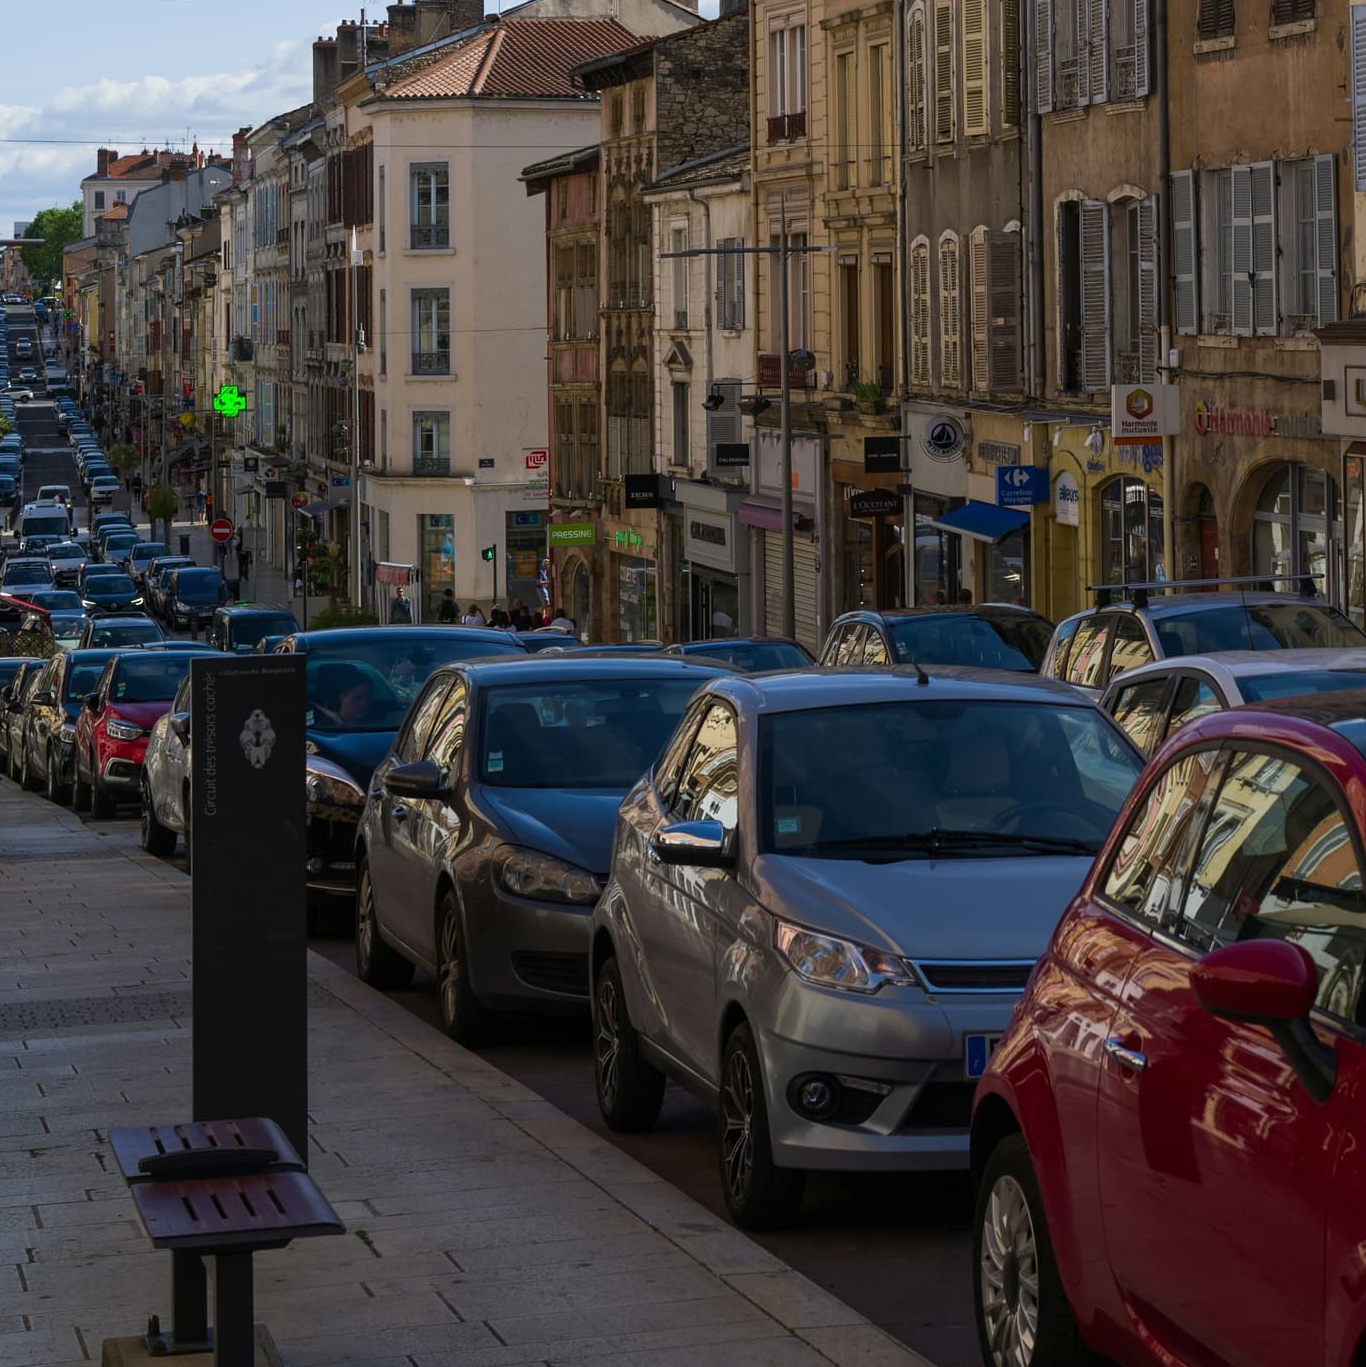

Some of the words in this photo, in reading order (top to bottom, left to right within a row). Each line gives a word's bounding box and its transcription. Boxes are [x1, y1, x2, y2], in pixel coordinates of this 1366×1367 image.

[1121, 420, 1158, 428] Harmonie
[1211, 408, 1274, 437] Harmonie
[1001, 489, 1035, 498] Carrefour
[1003, 497, 1033, 507] Voyages
[551, 530, 592, 539] PRESSING
[203, 755, 218, 776] des
[203, 776, 218, 817] Circuit
